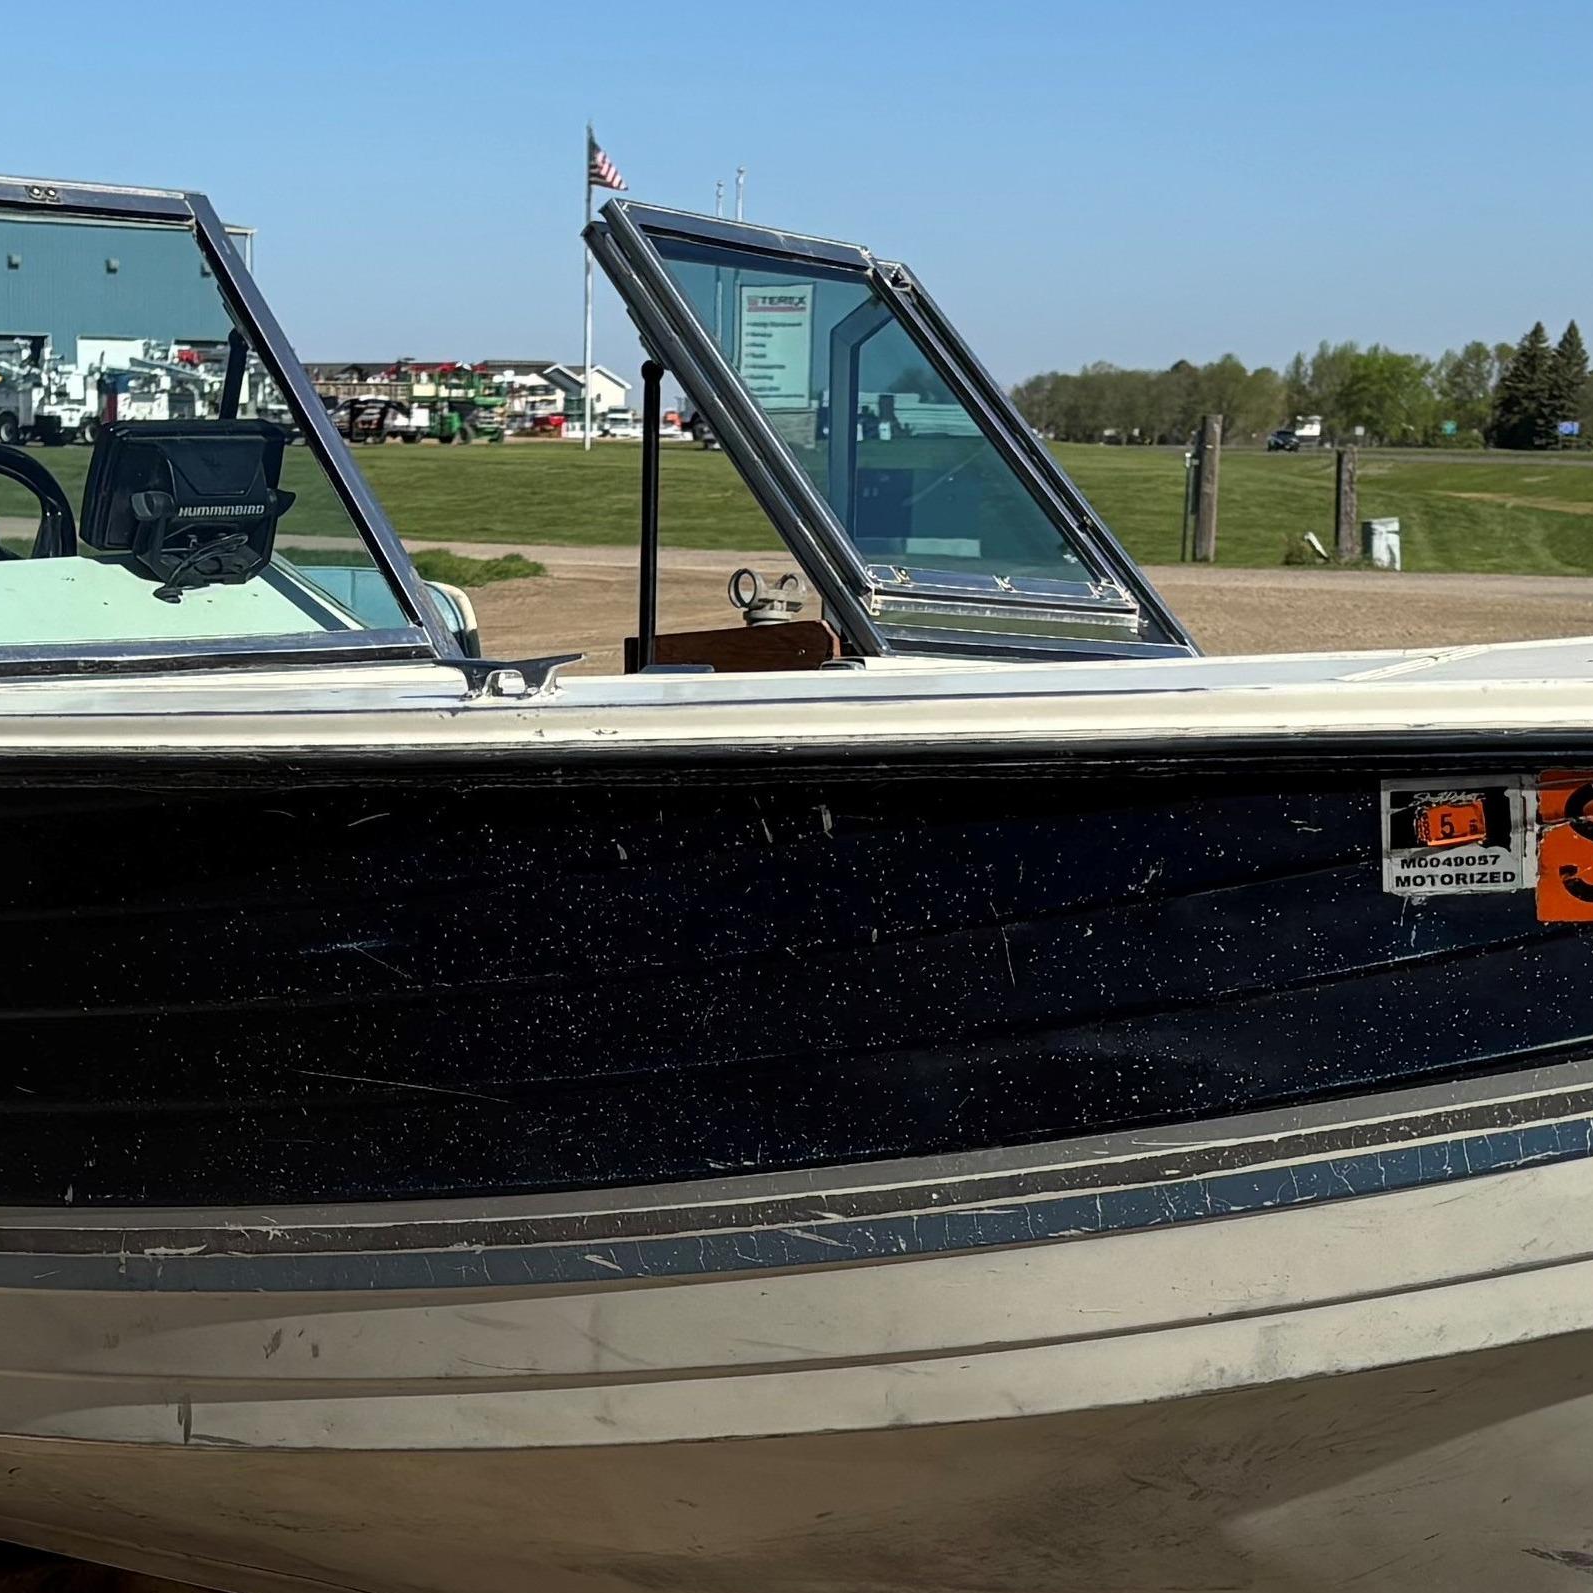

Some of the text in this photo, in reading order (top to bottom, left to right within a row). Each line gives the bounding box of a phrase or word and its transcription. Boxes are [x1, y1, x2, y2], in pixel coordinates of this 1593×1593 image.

[178, 505, 265, 517] HUMMINBIRD
[1440, 813, 1455, 838] 5
[1395, 871, 1516, 887] MOTORIZED
